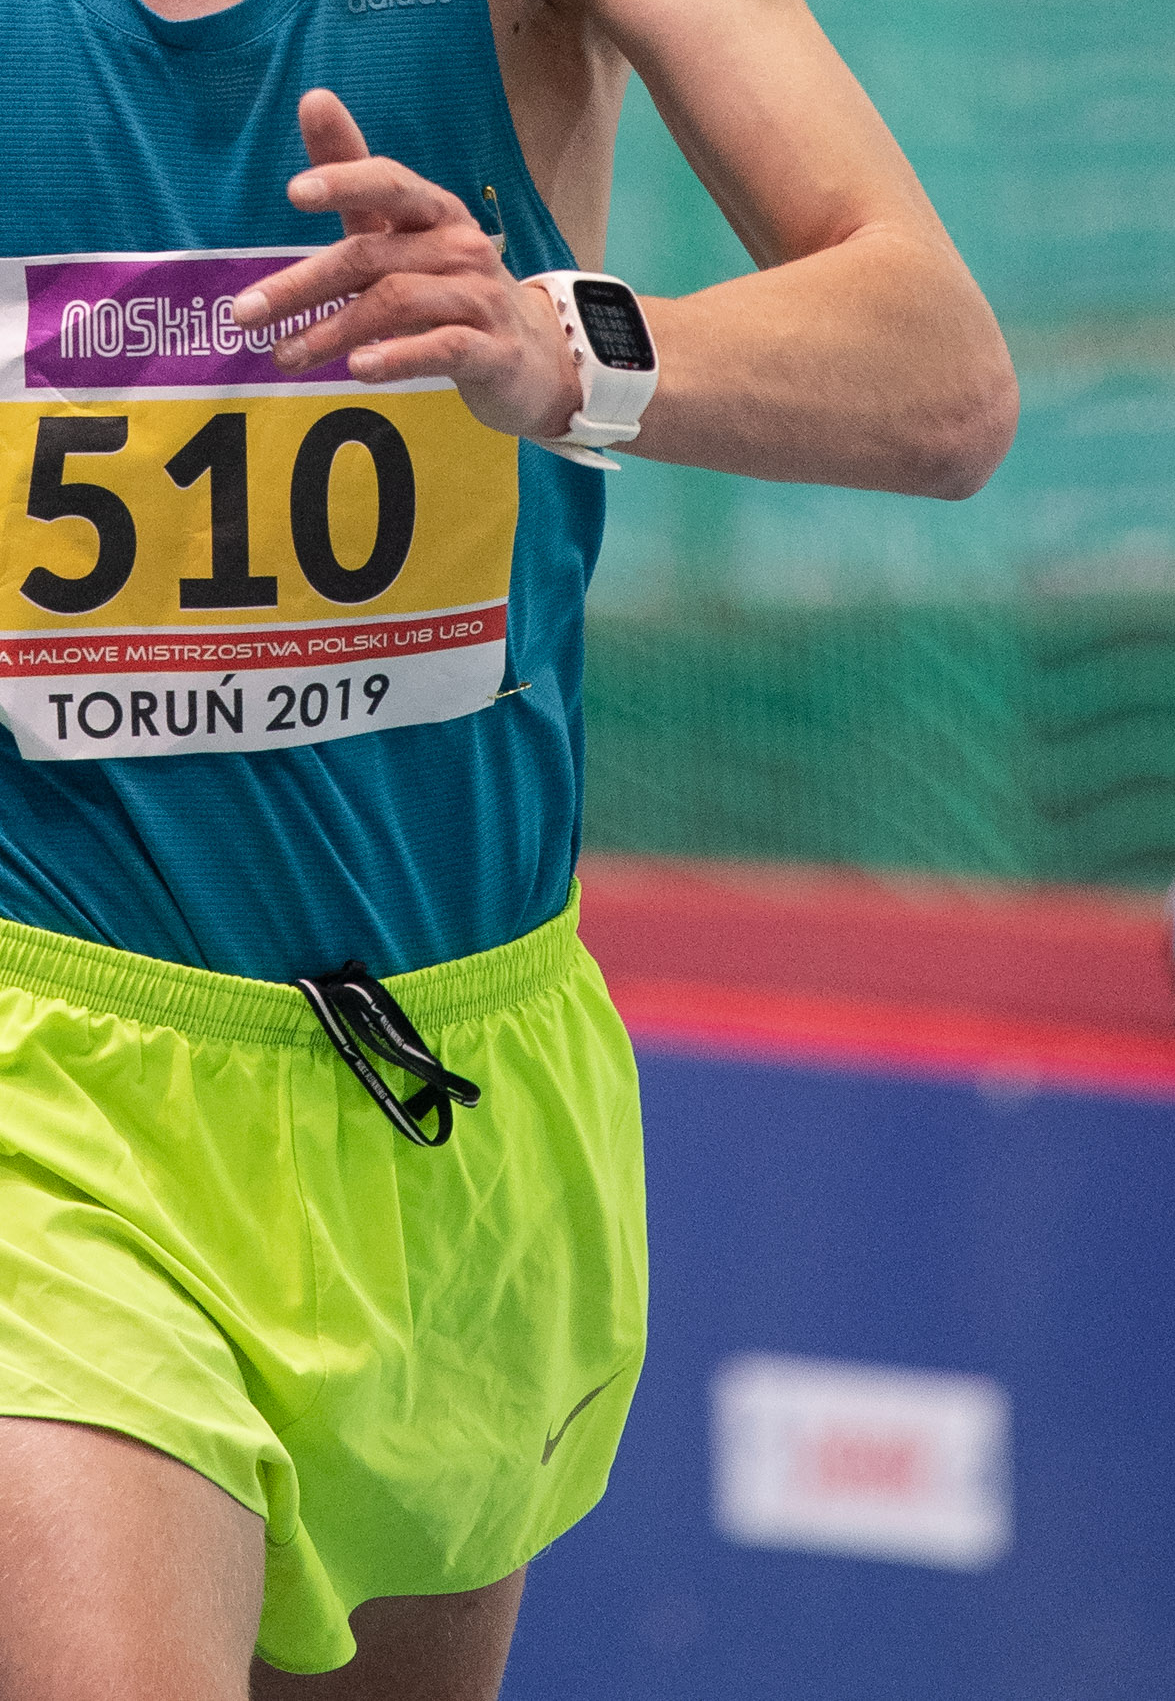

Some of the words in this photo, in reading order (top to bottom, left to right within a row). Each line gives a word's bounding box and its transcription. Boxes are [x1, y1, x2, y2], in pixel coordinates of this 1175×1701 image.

[18, 406, 416, 614] 510
[18, 646, 120, 665] HALOWE
[125, 641, 302, 662] MISTRZOSTWA
[308, 632, 388, 656] POLSKI
[394, 628, 433, 646] U18
[439, 619, 484, 640] U20
[48, 673, 244, 740] TORUŃ
[265, 672, 391, 732] 2019
